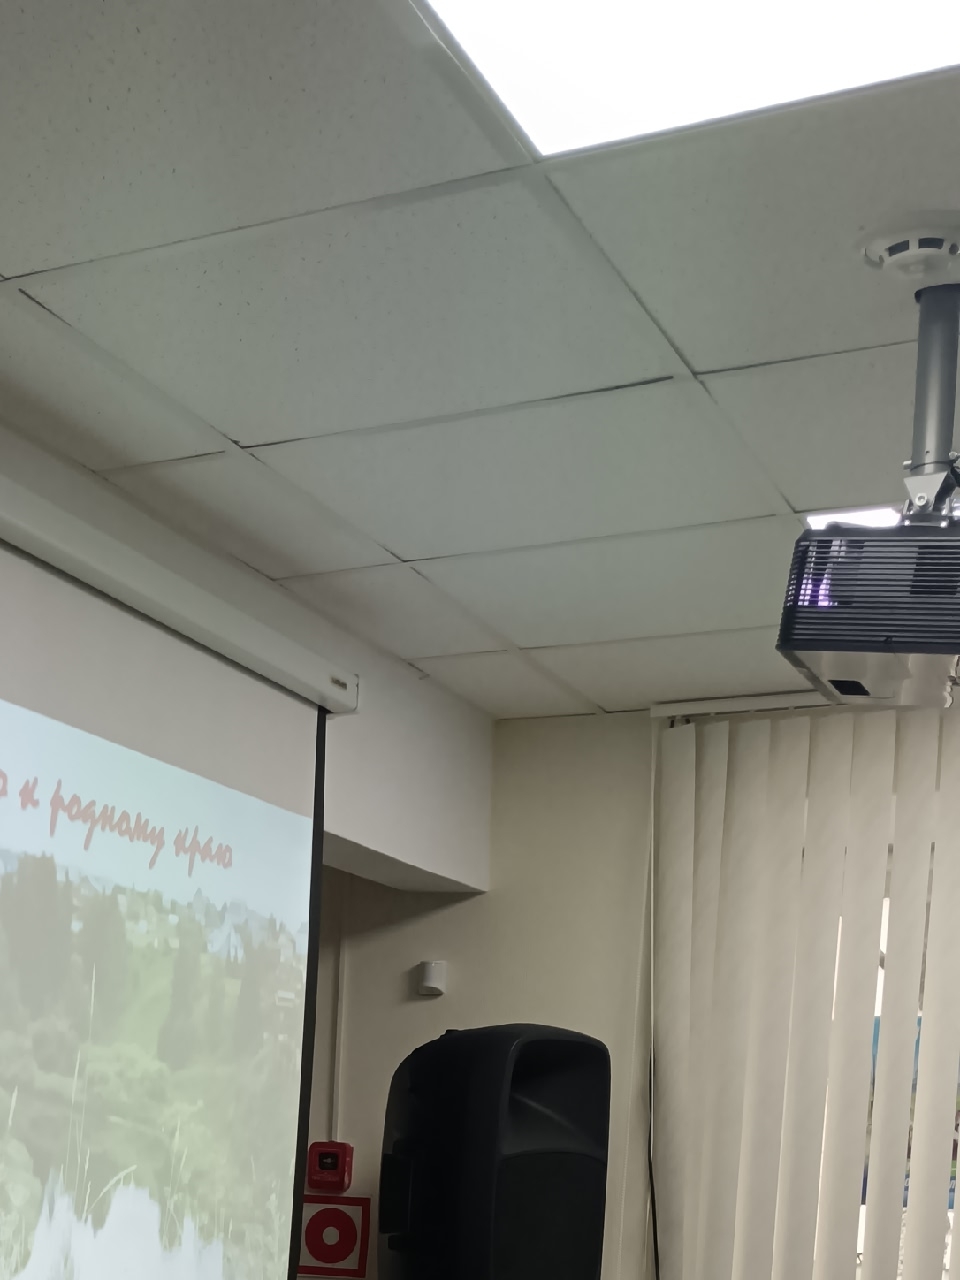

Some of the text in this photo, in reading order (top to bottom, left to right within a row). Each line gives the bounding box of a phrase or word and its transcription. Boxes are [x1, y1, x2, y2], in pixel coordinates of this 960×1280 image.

[18, 776, 40, 811] к
[49, 779, 165, 869] родному
[173, 825, 234, 878] краю
